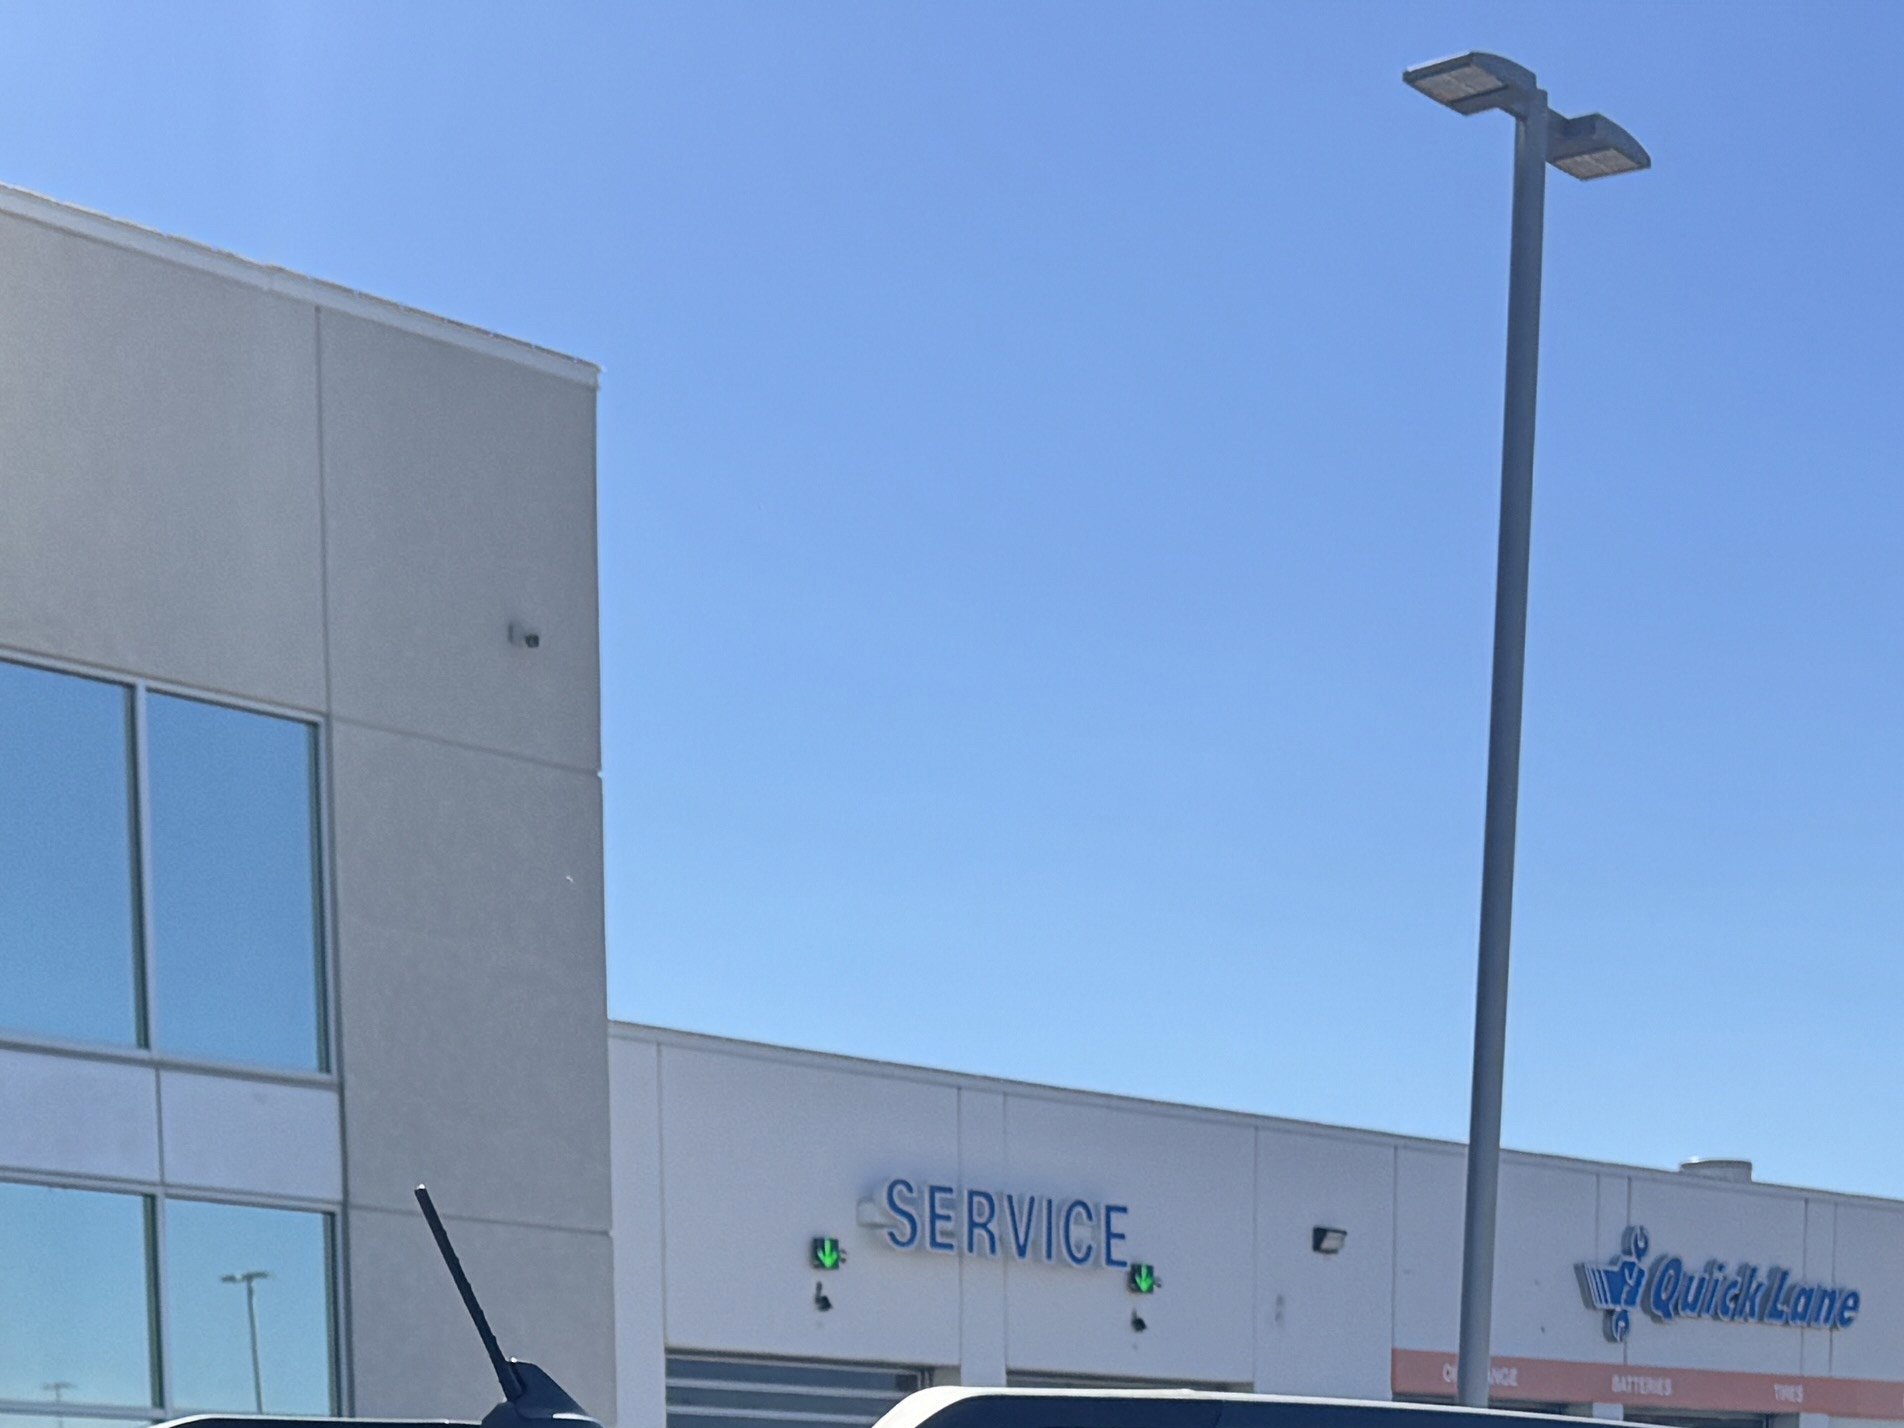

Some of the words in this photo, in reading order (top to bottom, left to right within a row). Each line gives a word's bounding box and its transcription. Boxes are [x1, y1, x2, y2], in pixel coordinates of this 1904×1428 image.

[887, 1178, 1129, 1268] SERVICE
[1649, 1256, 1765, 1323] Quick
[1763, 1268, 1861, 1329] Lane
[1611, 1373, 1672, 1396] BATTERIES
